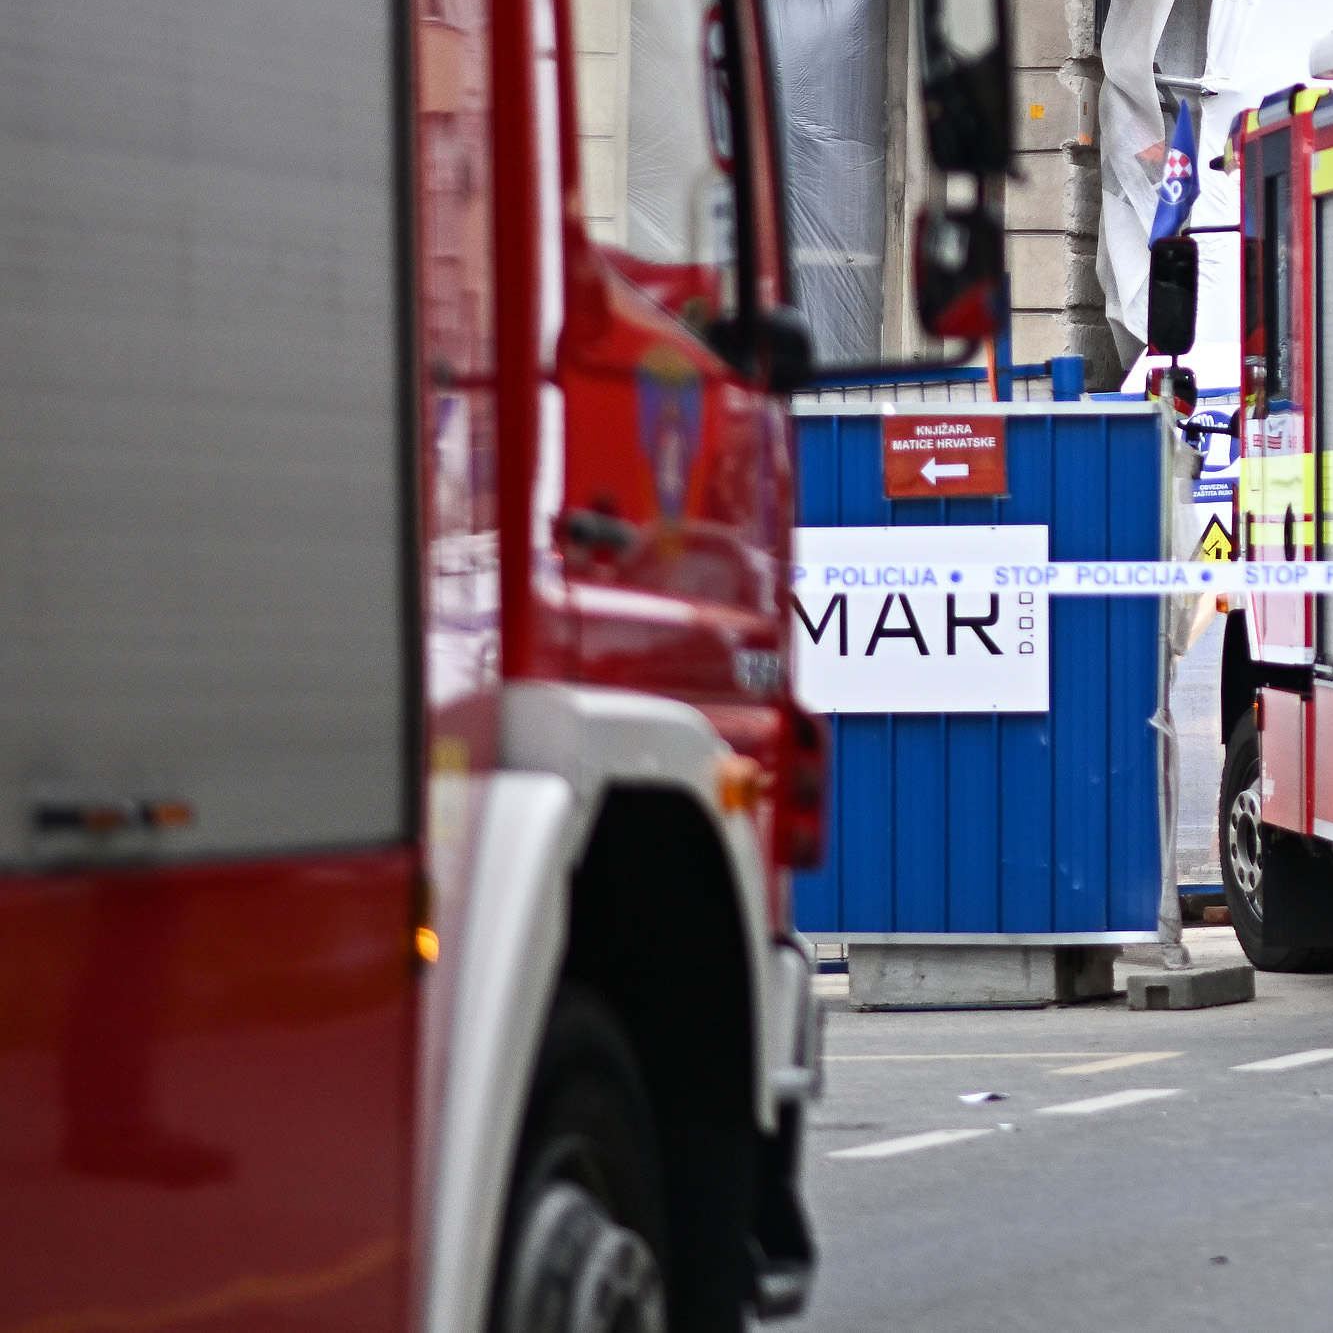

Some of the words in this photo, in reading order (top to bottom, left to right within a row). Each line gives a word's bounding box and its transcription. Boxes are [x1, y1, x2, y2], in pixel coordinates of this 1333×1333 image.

[915, 422, 973, 436] KNJIŽARA
[891, 439, 935, 451] MATICE
[936, 436, 997, 449] HRVATSKE
[824, 567, 938, 587] POLICIJA
[994, 566, 1059, 587] STOP
[1076, 566, 1188, 587] POLICIJA
[1244, 564, 1308, 586] STOP
[789, 591, 1004, 657] MAR
[1018, 591, 1035, 655] D.O.O
